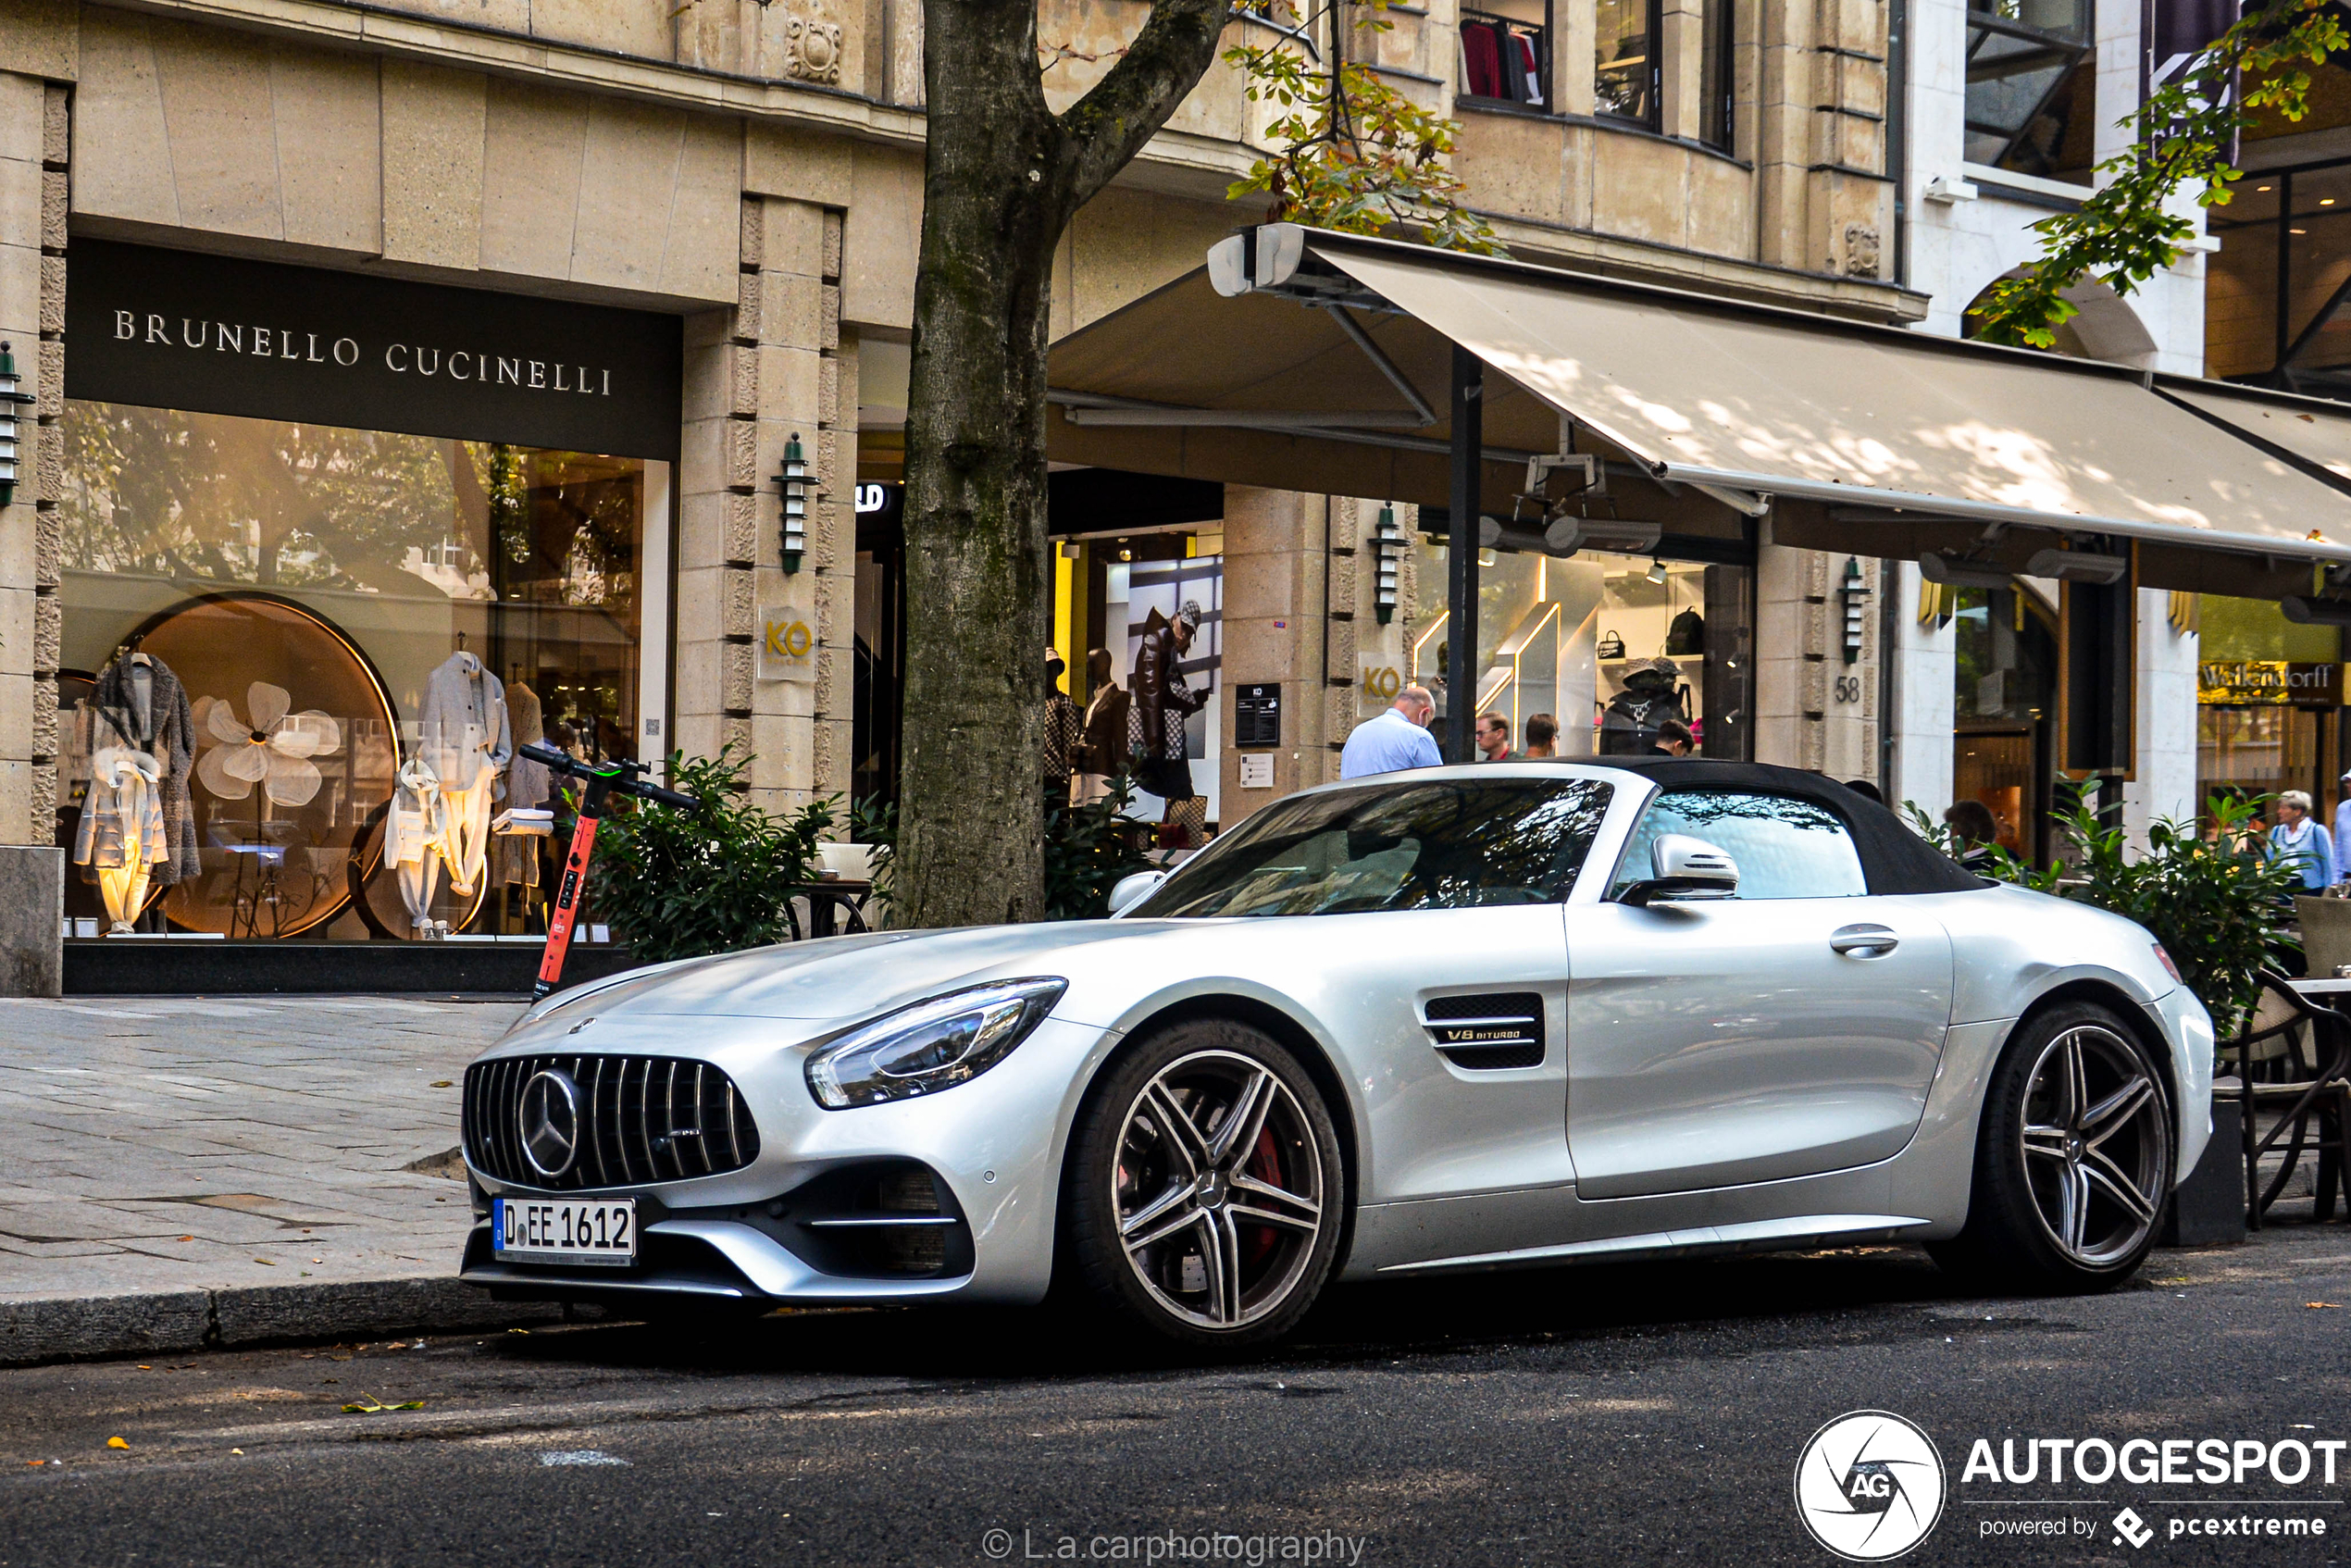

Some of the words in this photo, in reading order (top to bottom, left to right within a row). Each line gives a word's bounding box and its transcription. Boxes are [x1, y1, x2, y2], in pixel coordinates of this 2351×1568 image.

[113, 309, 360, 367] BRUNELLO
[385, 343, 611, 396] CUCINELLI
[1835, 676, 1860, 703] 58
[2203, 664, 2333, 688] Wellendorff
[1448, 1029, 1474, 1040] V8
[1476, 1030, 1521, 1039] BITURBO
[504, 1204, 516, 1245] D
[528, 1206, 555, 1247] EE
[561, 1206, 629, 1249] 1612
